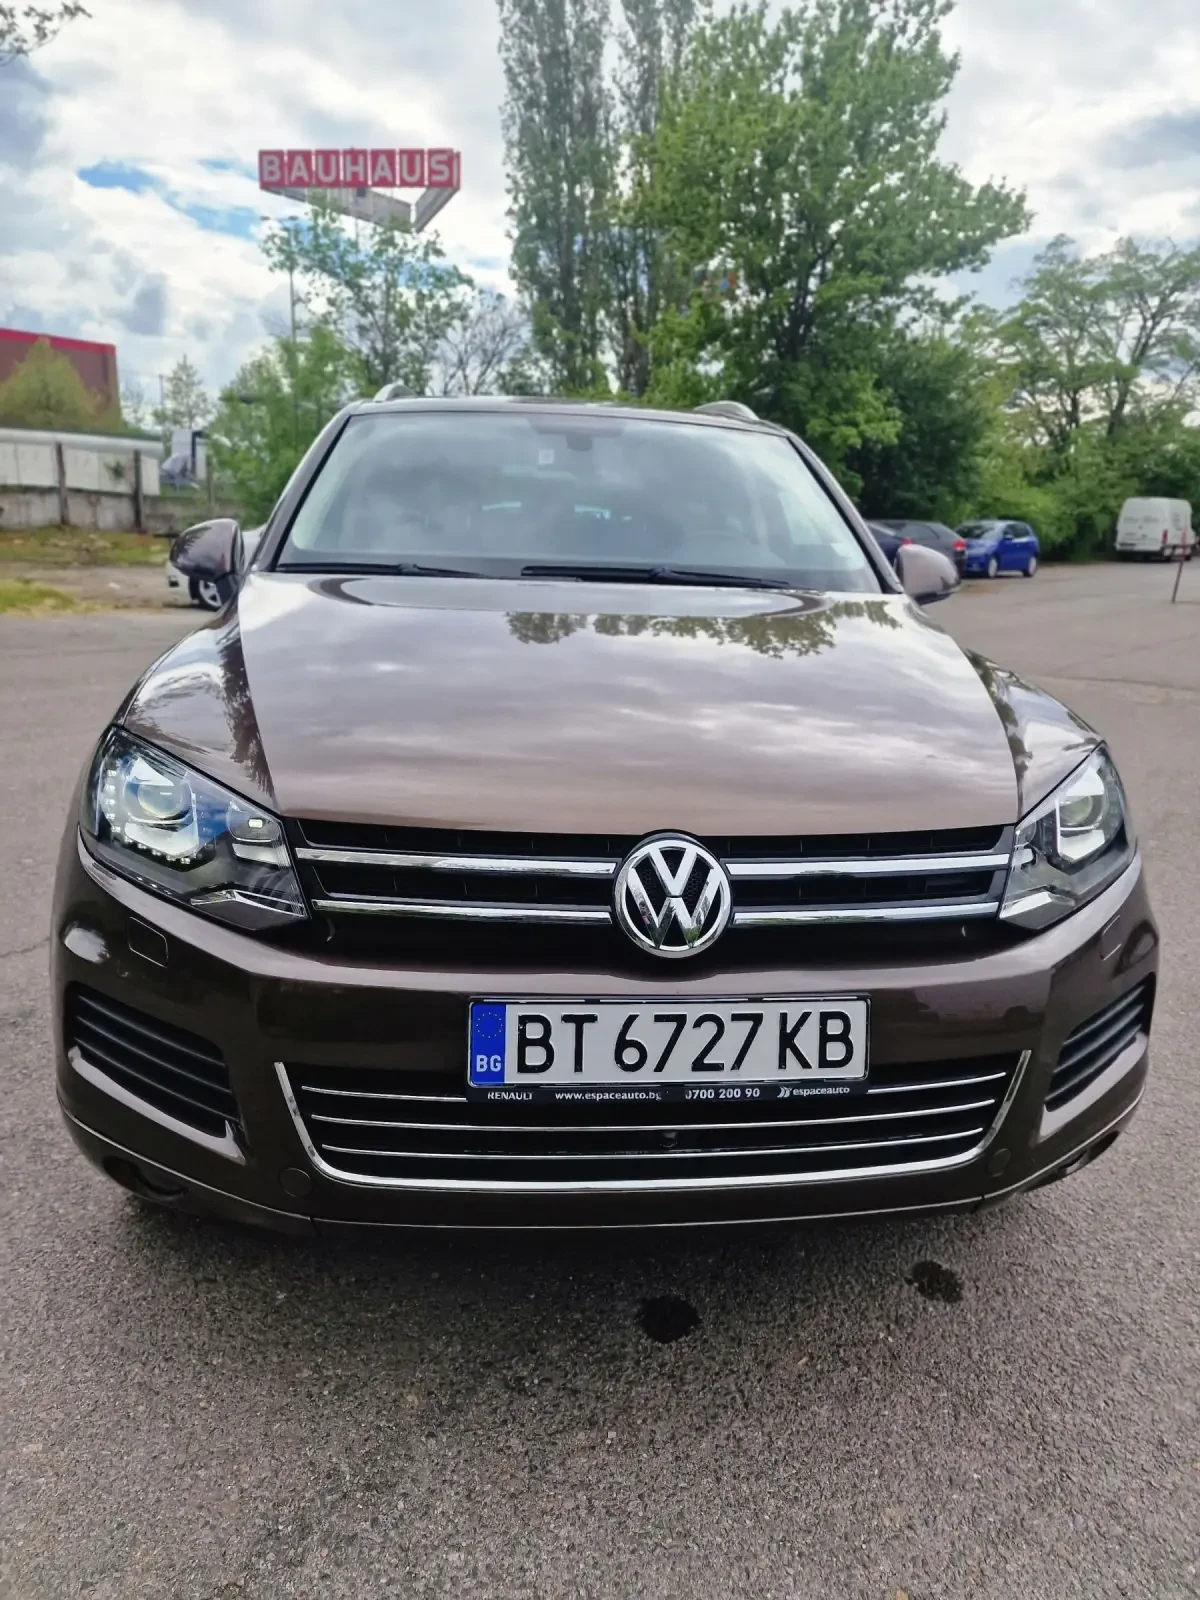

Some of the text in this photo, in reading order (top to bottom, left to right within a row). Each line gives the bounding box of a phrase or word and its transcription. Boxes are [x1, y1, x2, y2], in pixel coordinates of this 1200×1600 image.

[261, 154, 450, 183] BAUHAUS
[517, 1010, 854, 1074] BT 6727 KB
[476, 1054, 502, 1073] BG
[487, 1091, 533, 1100] RENAULT
[555, 1090, 662, 1101] www.espaceauto.bg
[718, 1088, 741, 1099] 200
[745, 1087, 761, 1098] 90
[793, 1086, 850, 1096] espaceauto
